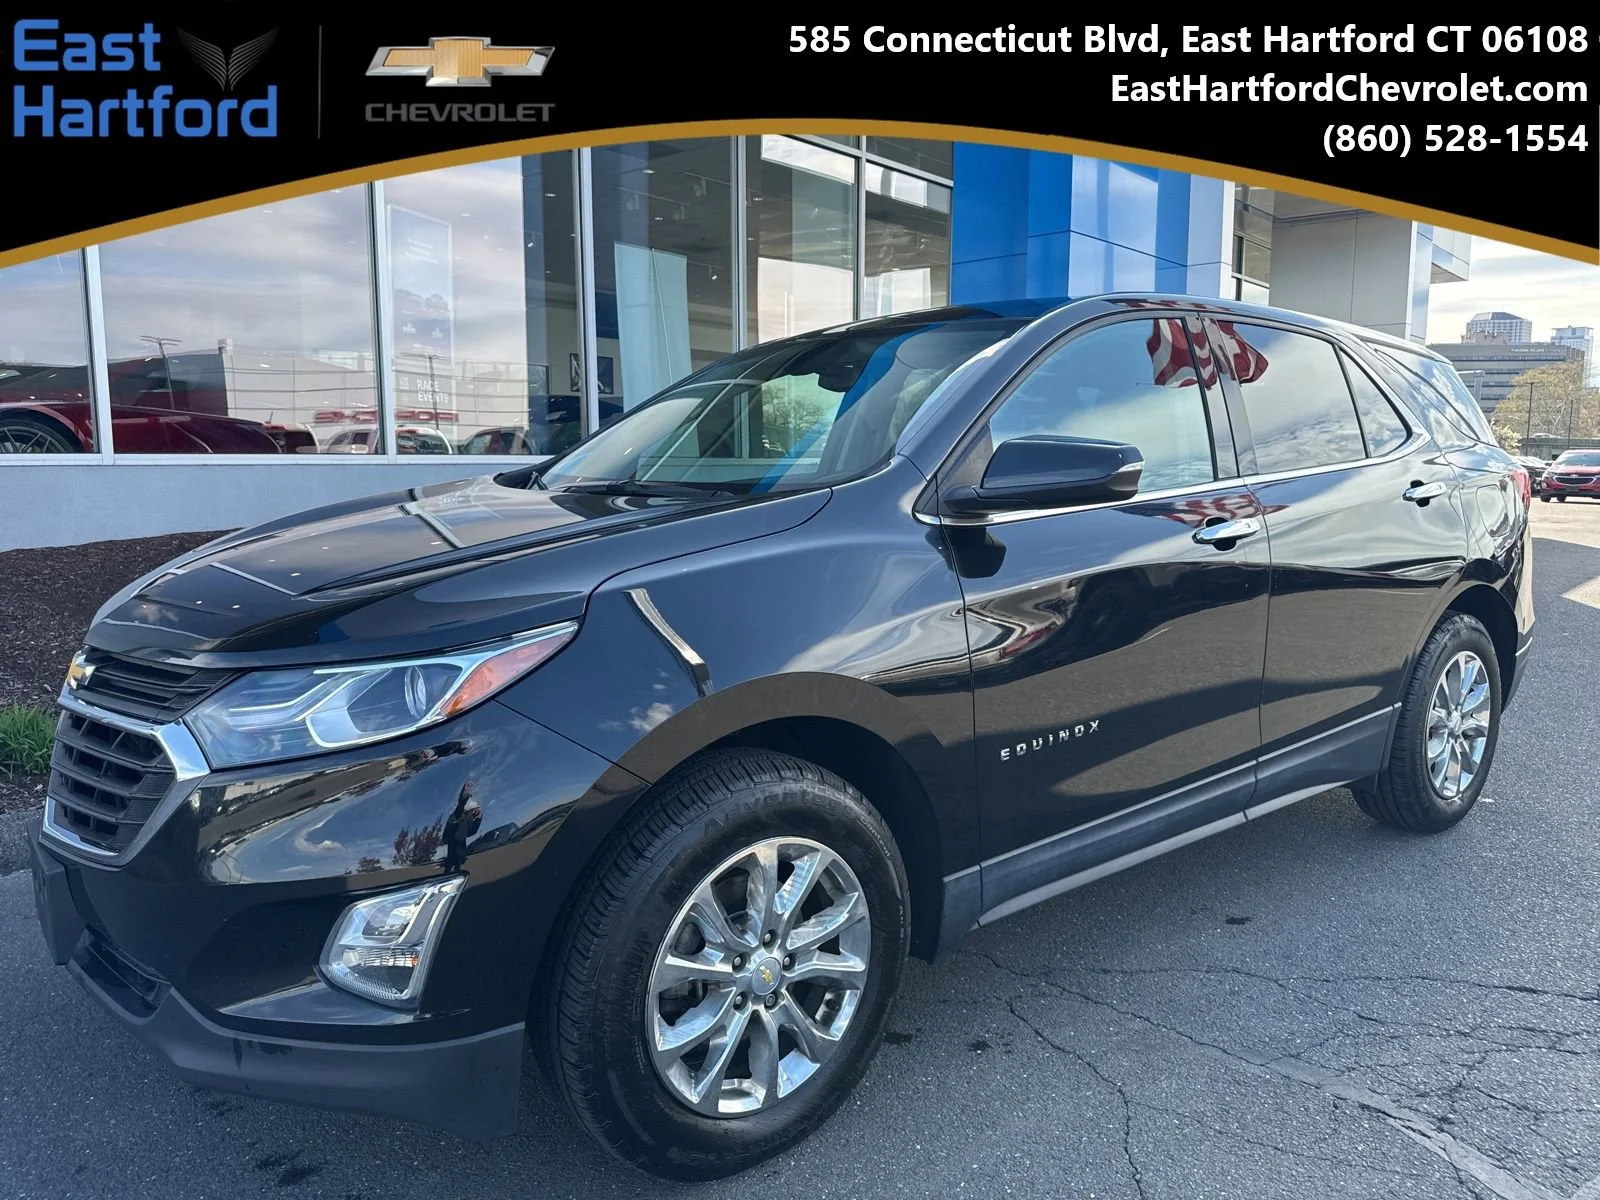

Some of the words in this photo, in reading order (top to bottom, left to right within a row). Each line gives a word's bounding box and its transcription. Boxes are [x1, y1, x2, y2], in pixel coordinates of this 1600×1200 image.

[417, 379, 440, 391] RACE
[418, 391, 449, 404] EVENTS
[1000, 719, 1100, 762] EQUINOX
